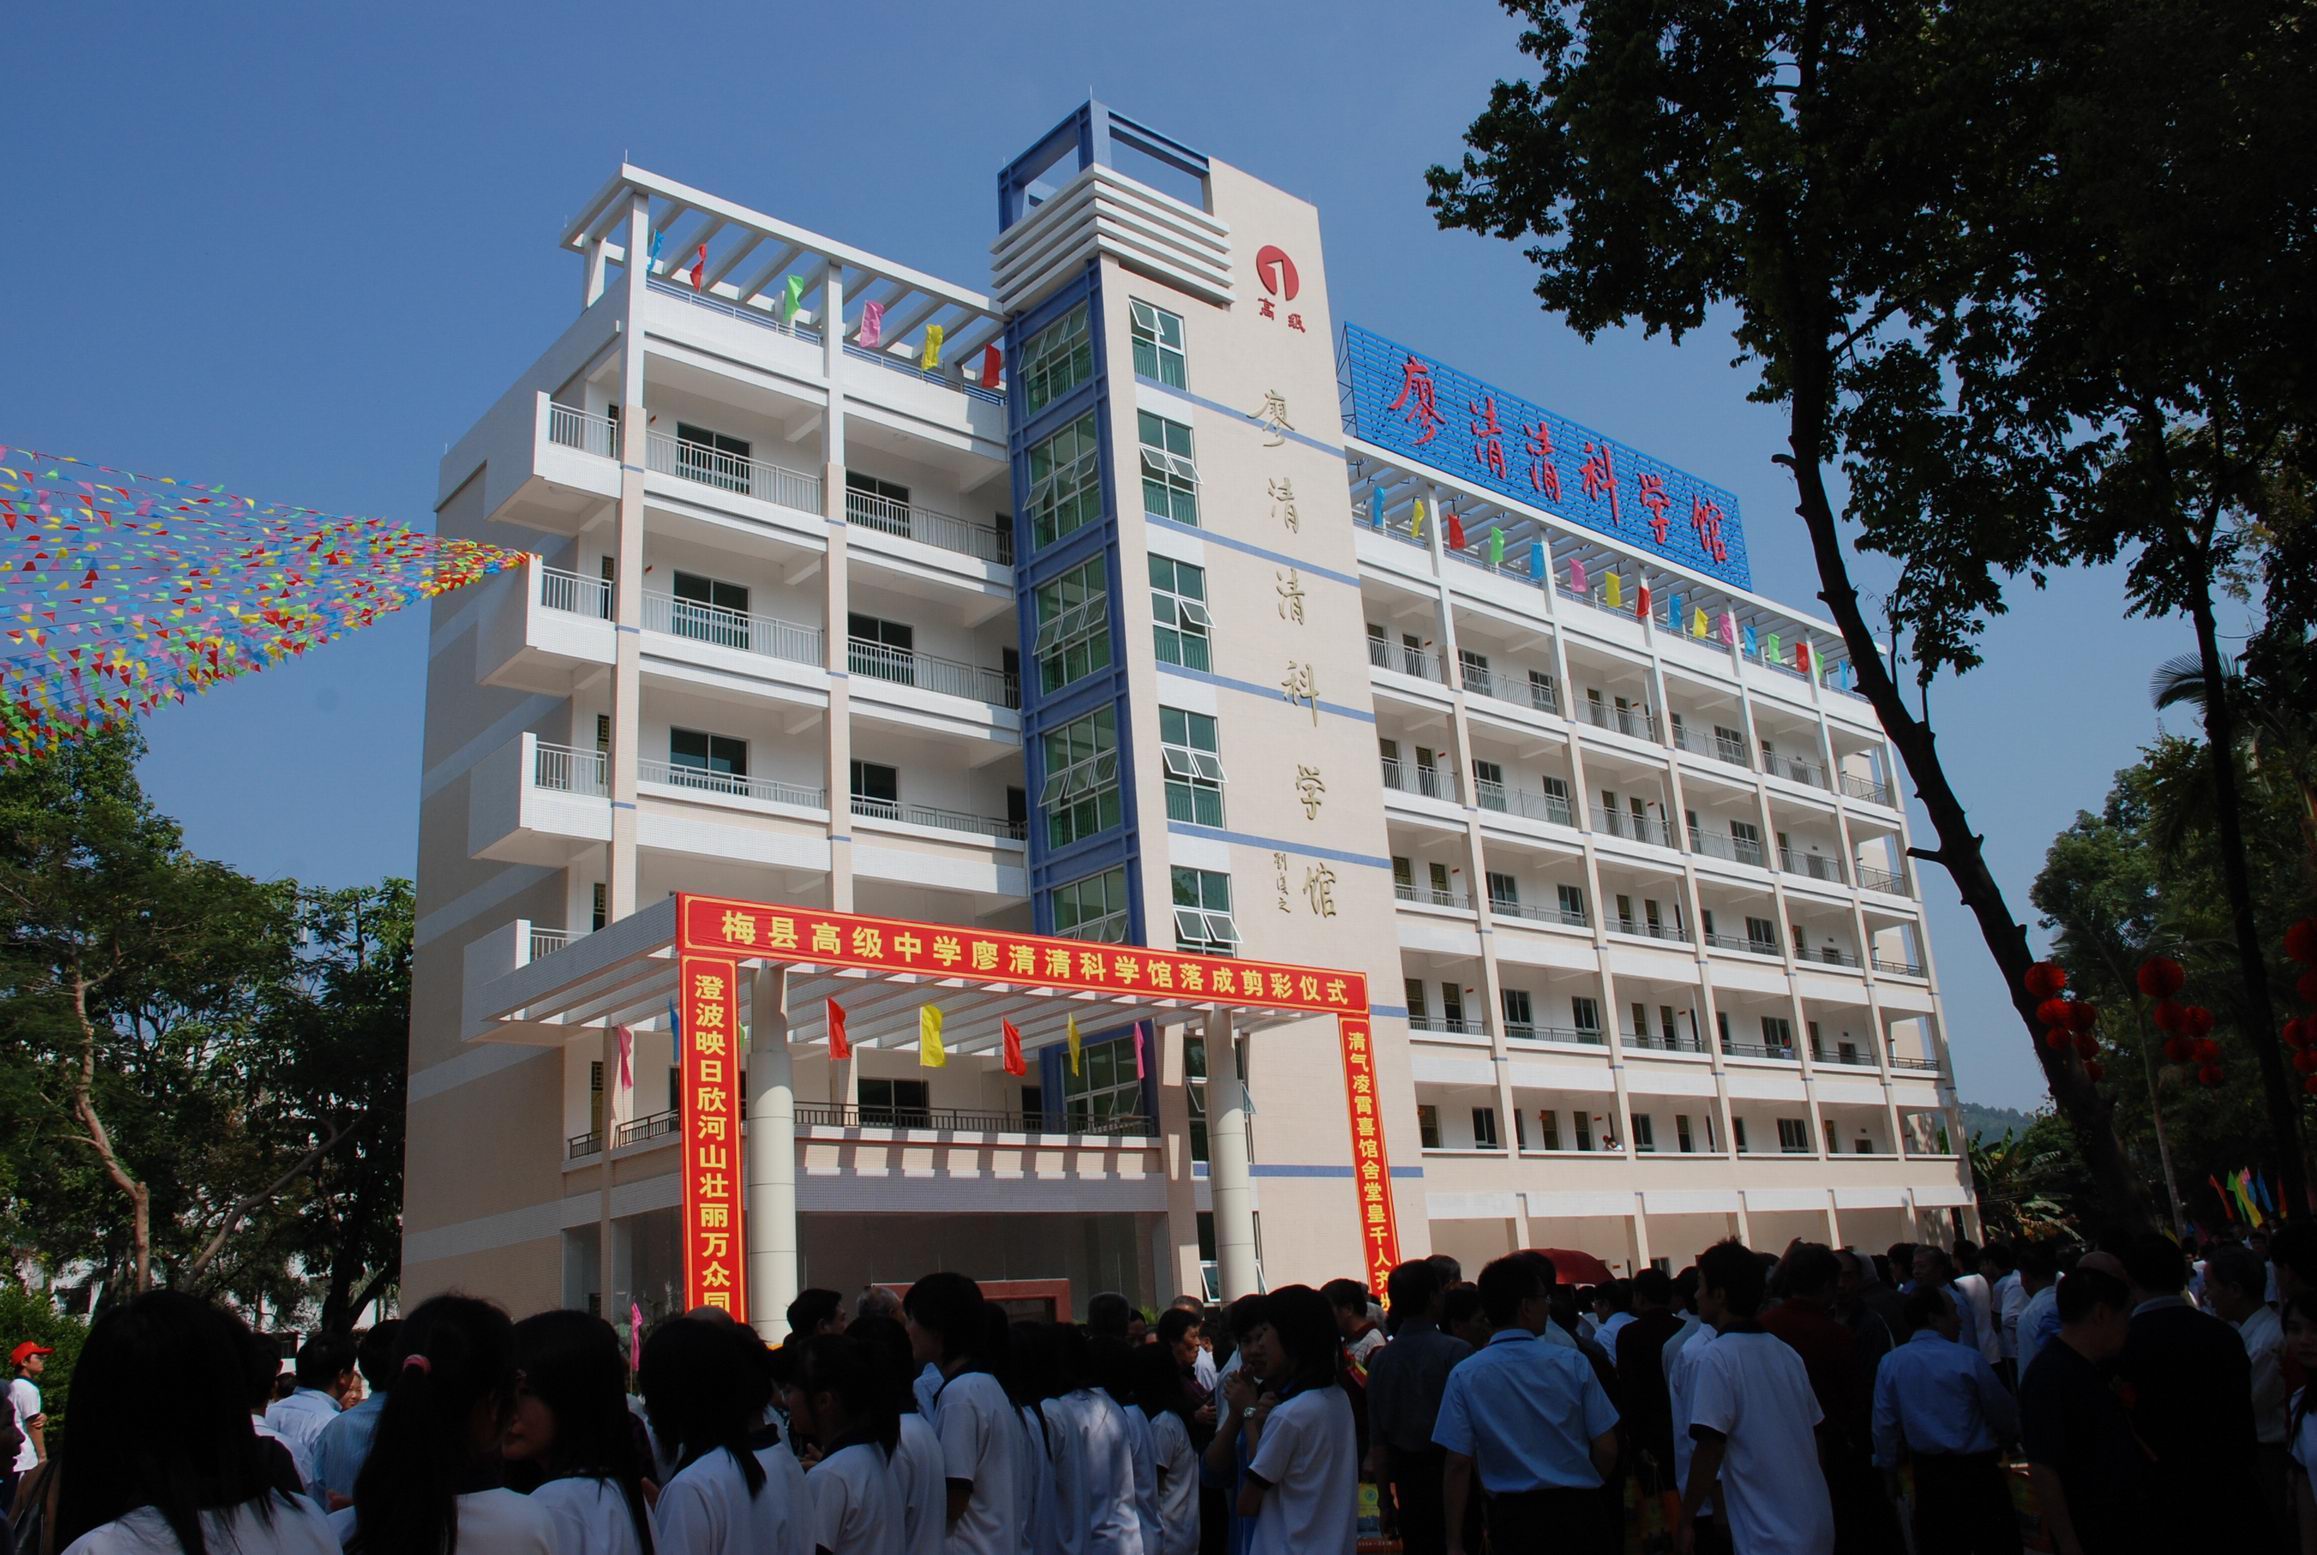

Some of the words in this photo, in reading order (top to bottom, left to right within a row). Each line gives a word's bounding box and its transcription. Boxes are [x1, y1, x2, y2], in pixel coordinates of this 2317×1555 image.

[721, 909, 1348, 1005] 梅县高级中学廖清清科学馆落成剪彩仪式
[694, 974, 731, 1313] 澄波映日欣河山壮丽万众同
